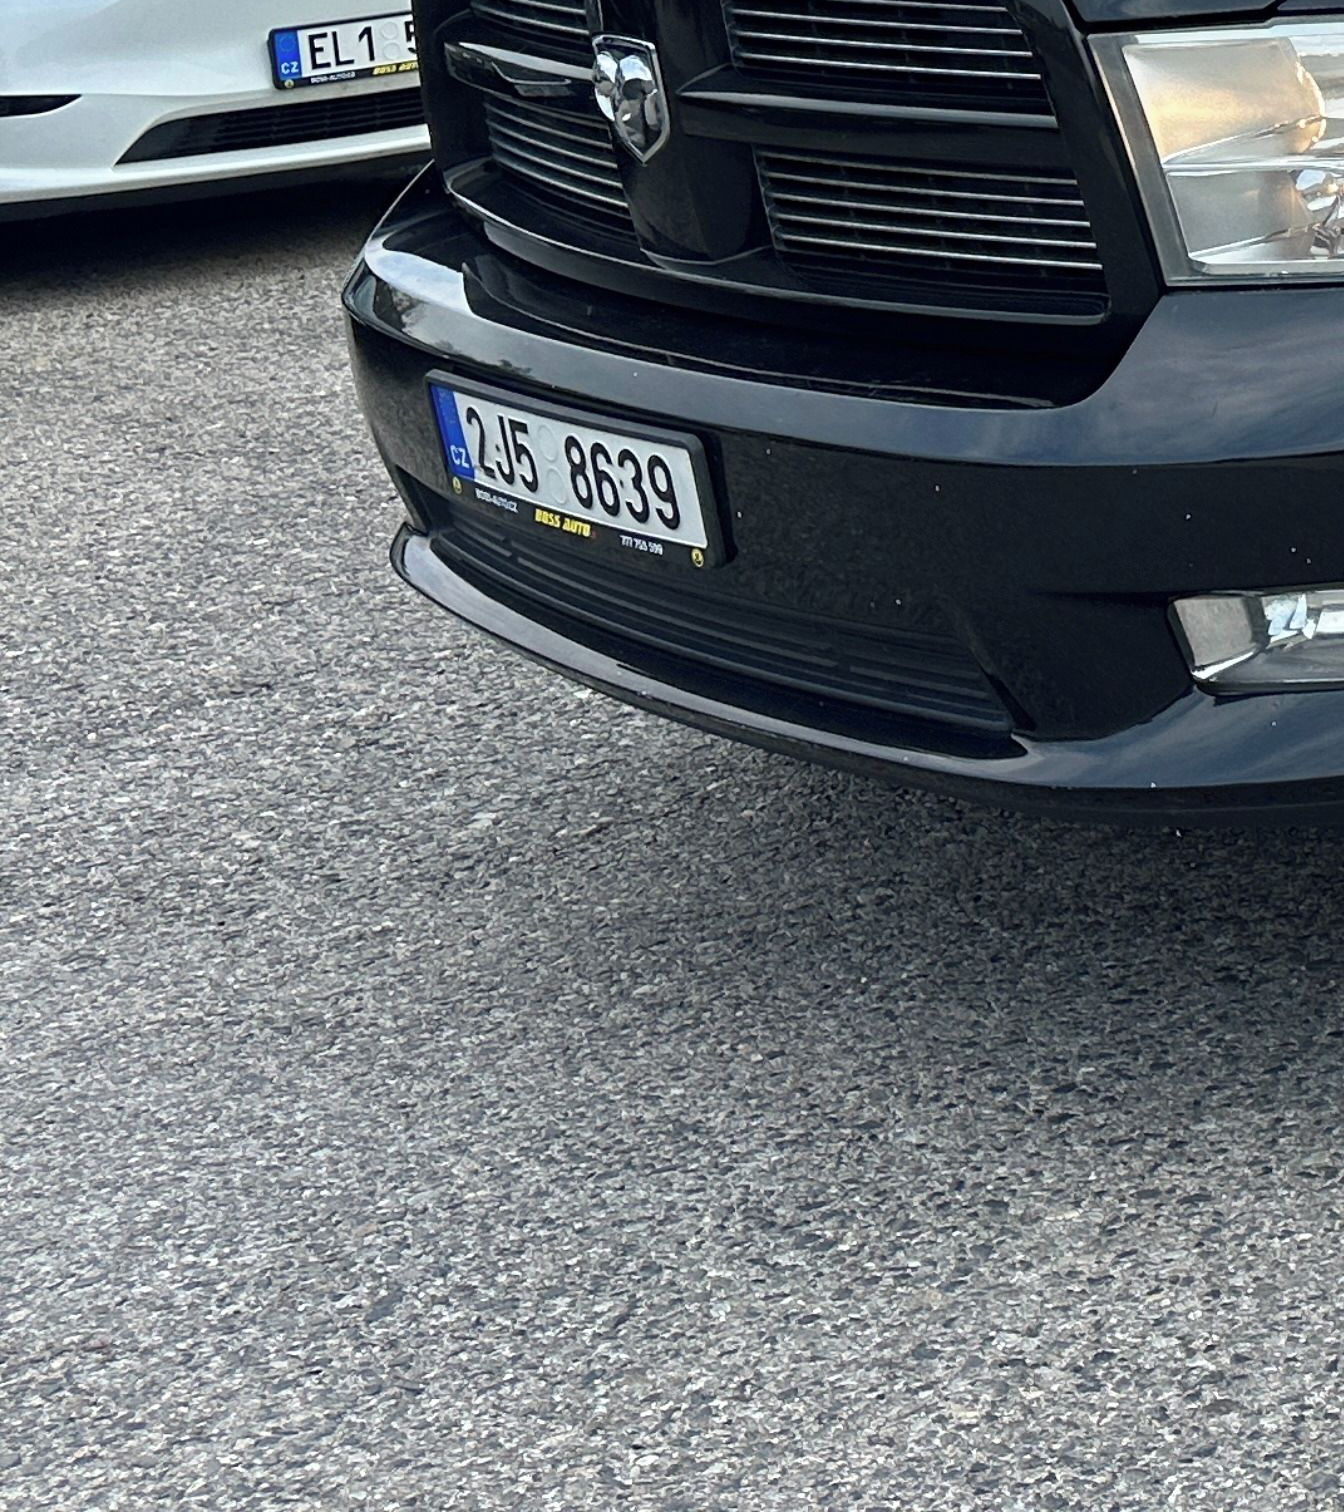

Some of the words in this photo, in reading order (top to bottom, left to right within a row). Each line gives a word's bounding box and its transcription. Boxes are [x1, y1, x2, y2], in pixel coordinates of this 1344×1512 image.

[307, 25, 375, 70] EL1
[280, 60, 300, 75] CZ
[450, 444, 470, 469] CZ
[465, 406, 539, 494] 2J5
[564, 434, 682, 531] 8639
